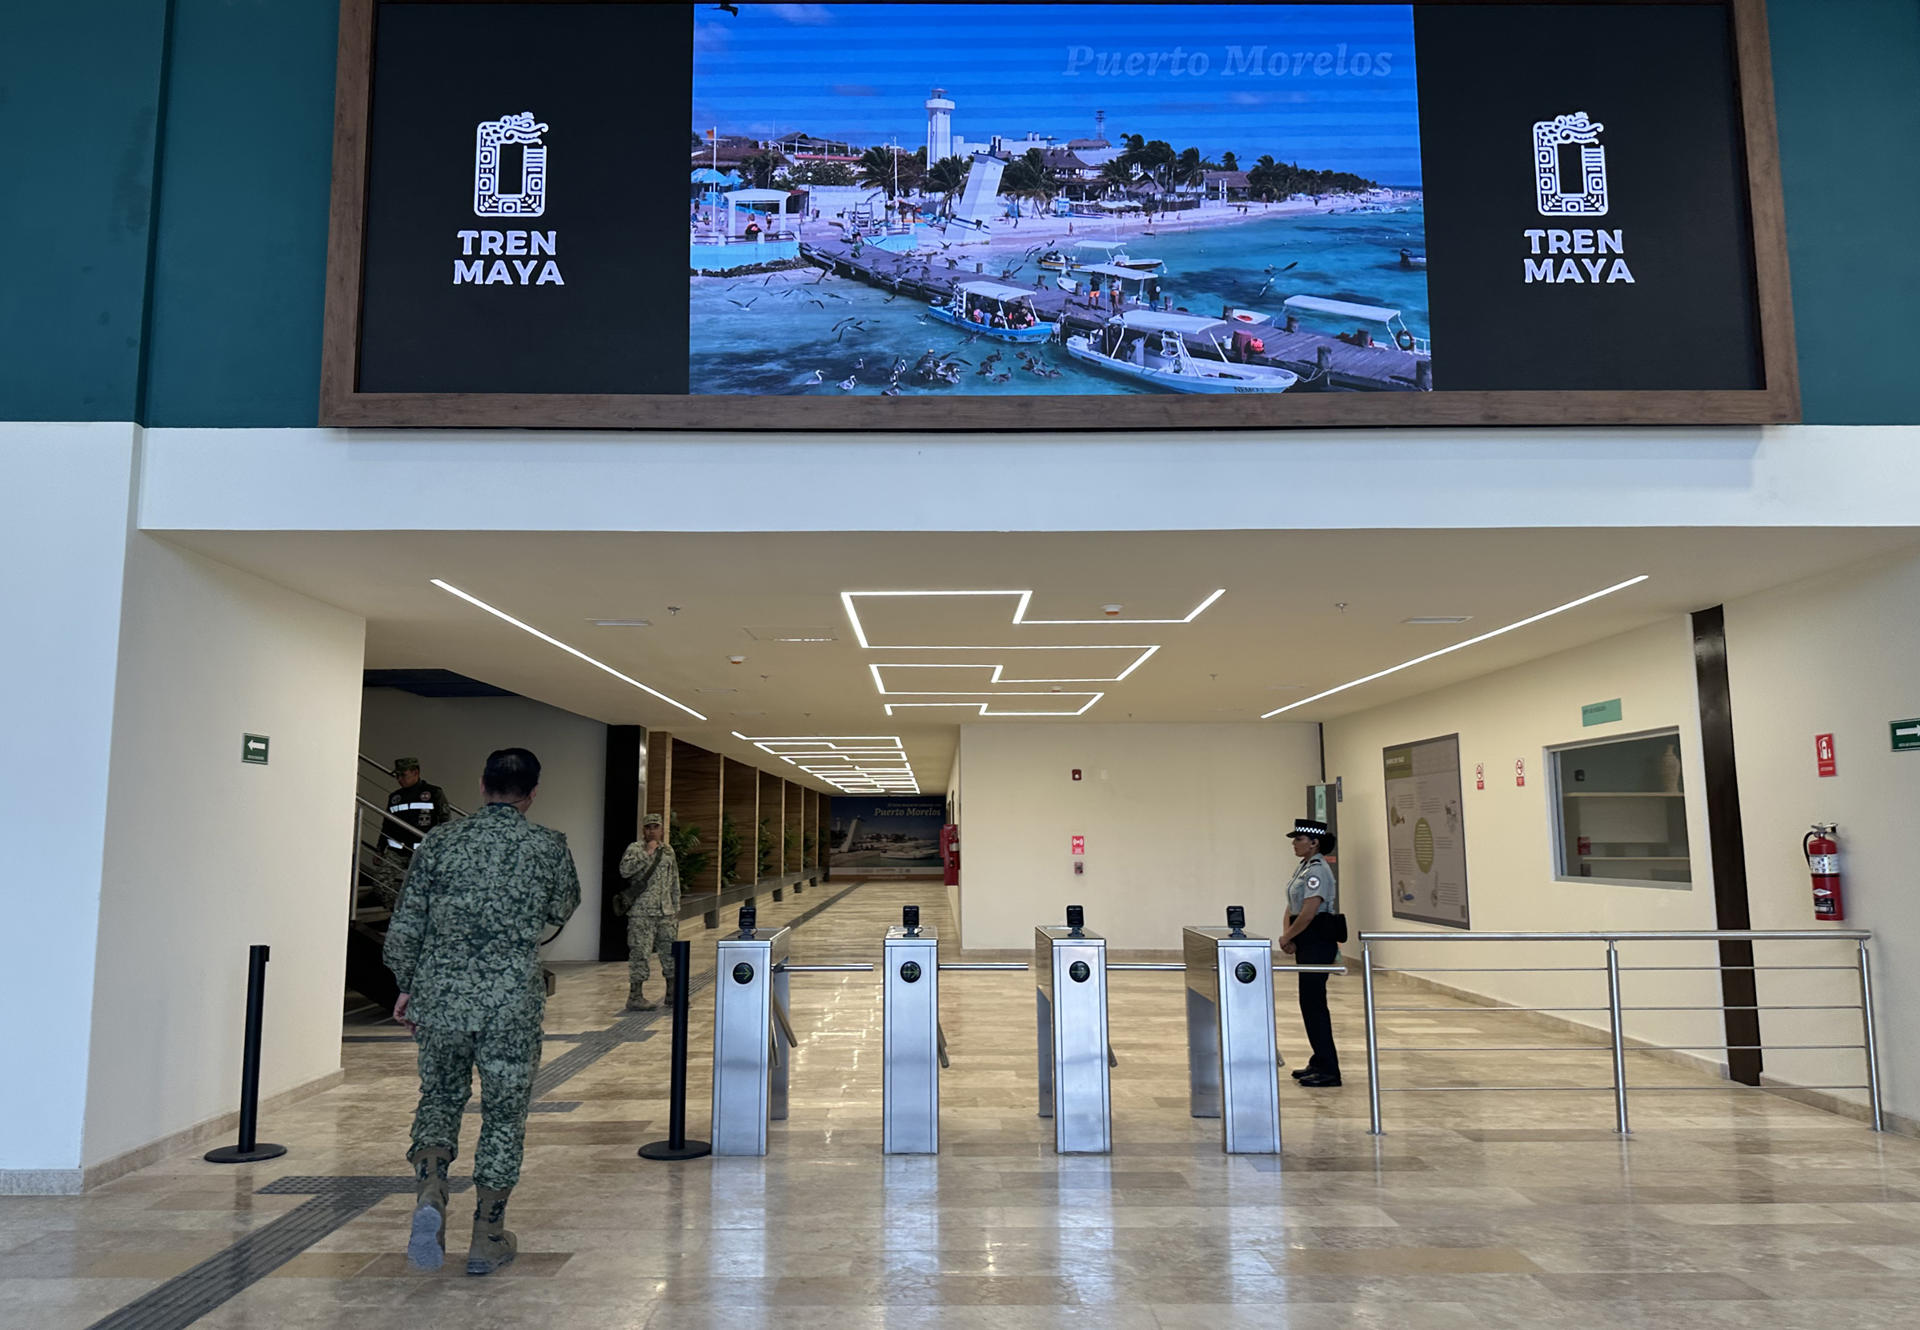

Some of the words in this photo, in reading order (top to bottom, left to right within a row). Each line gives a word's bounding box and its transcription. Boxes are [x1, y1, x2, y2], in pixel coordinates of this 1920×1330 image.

[1061, 44, 1211, 77] Puerto
[1220, 42, 1394, 77] Morelos
[456, 229, 557, 256] TREN
[1523, 228, 1625, 255] TREN
[452, 259, 565, 286] MAYA
[1522, 257, 1636, 284] MAYA
[873, 807, 905, 817] Puerto
[906, 807, 941, 817] Morelos
